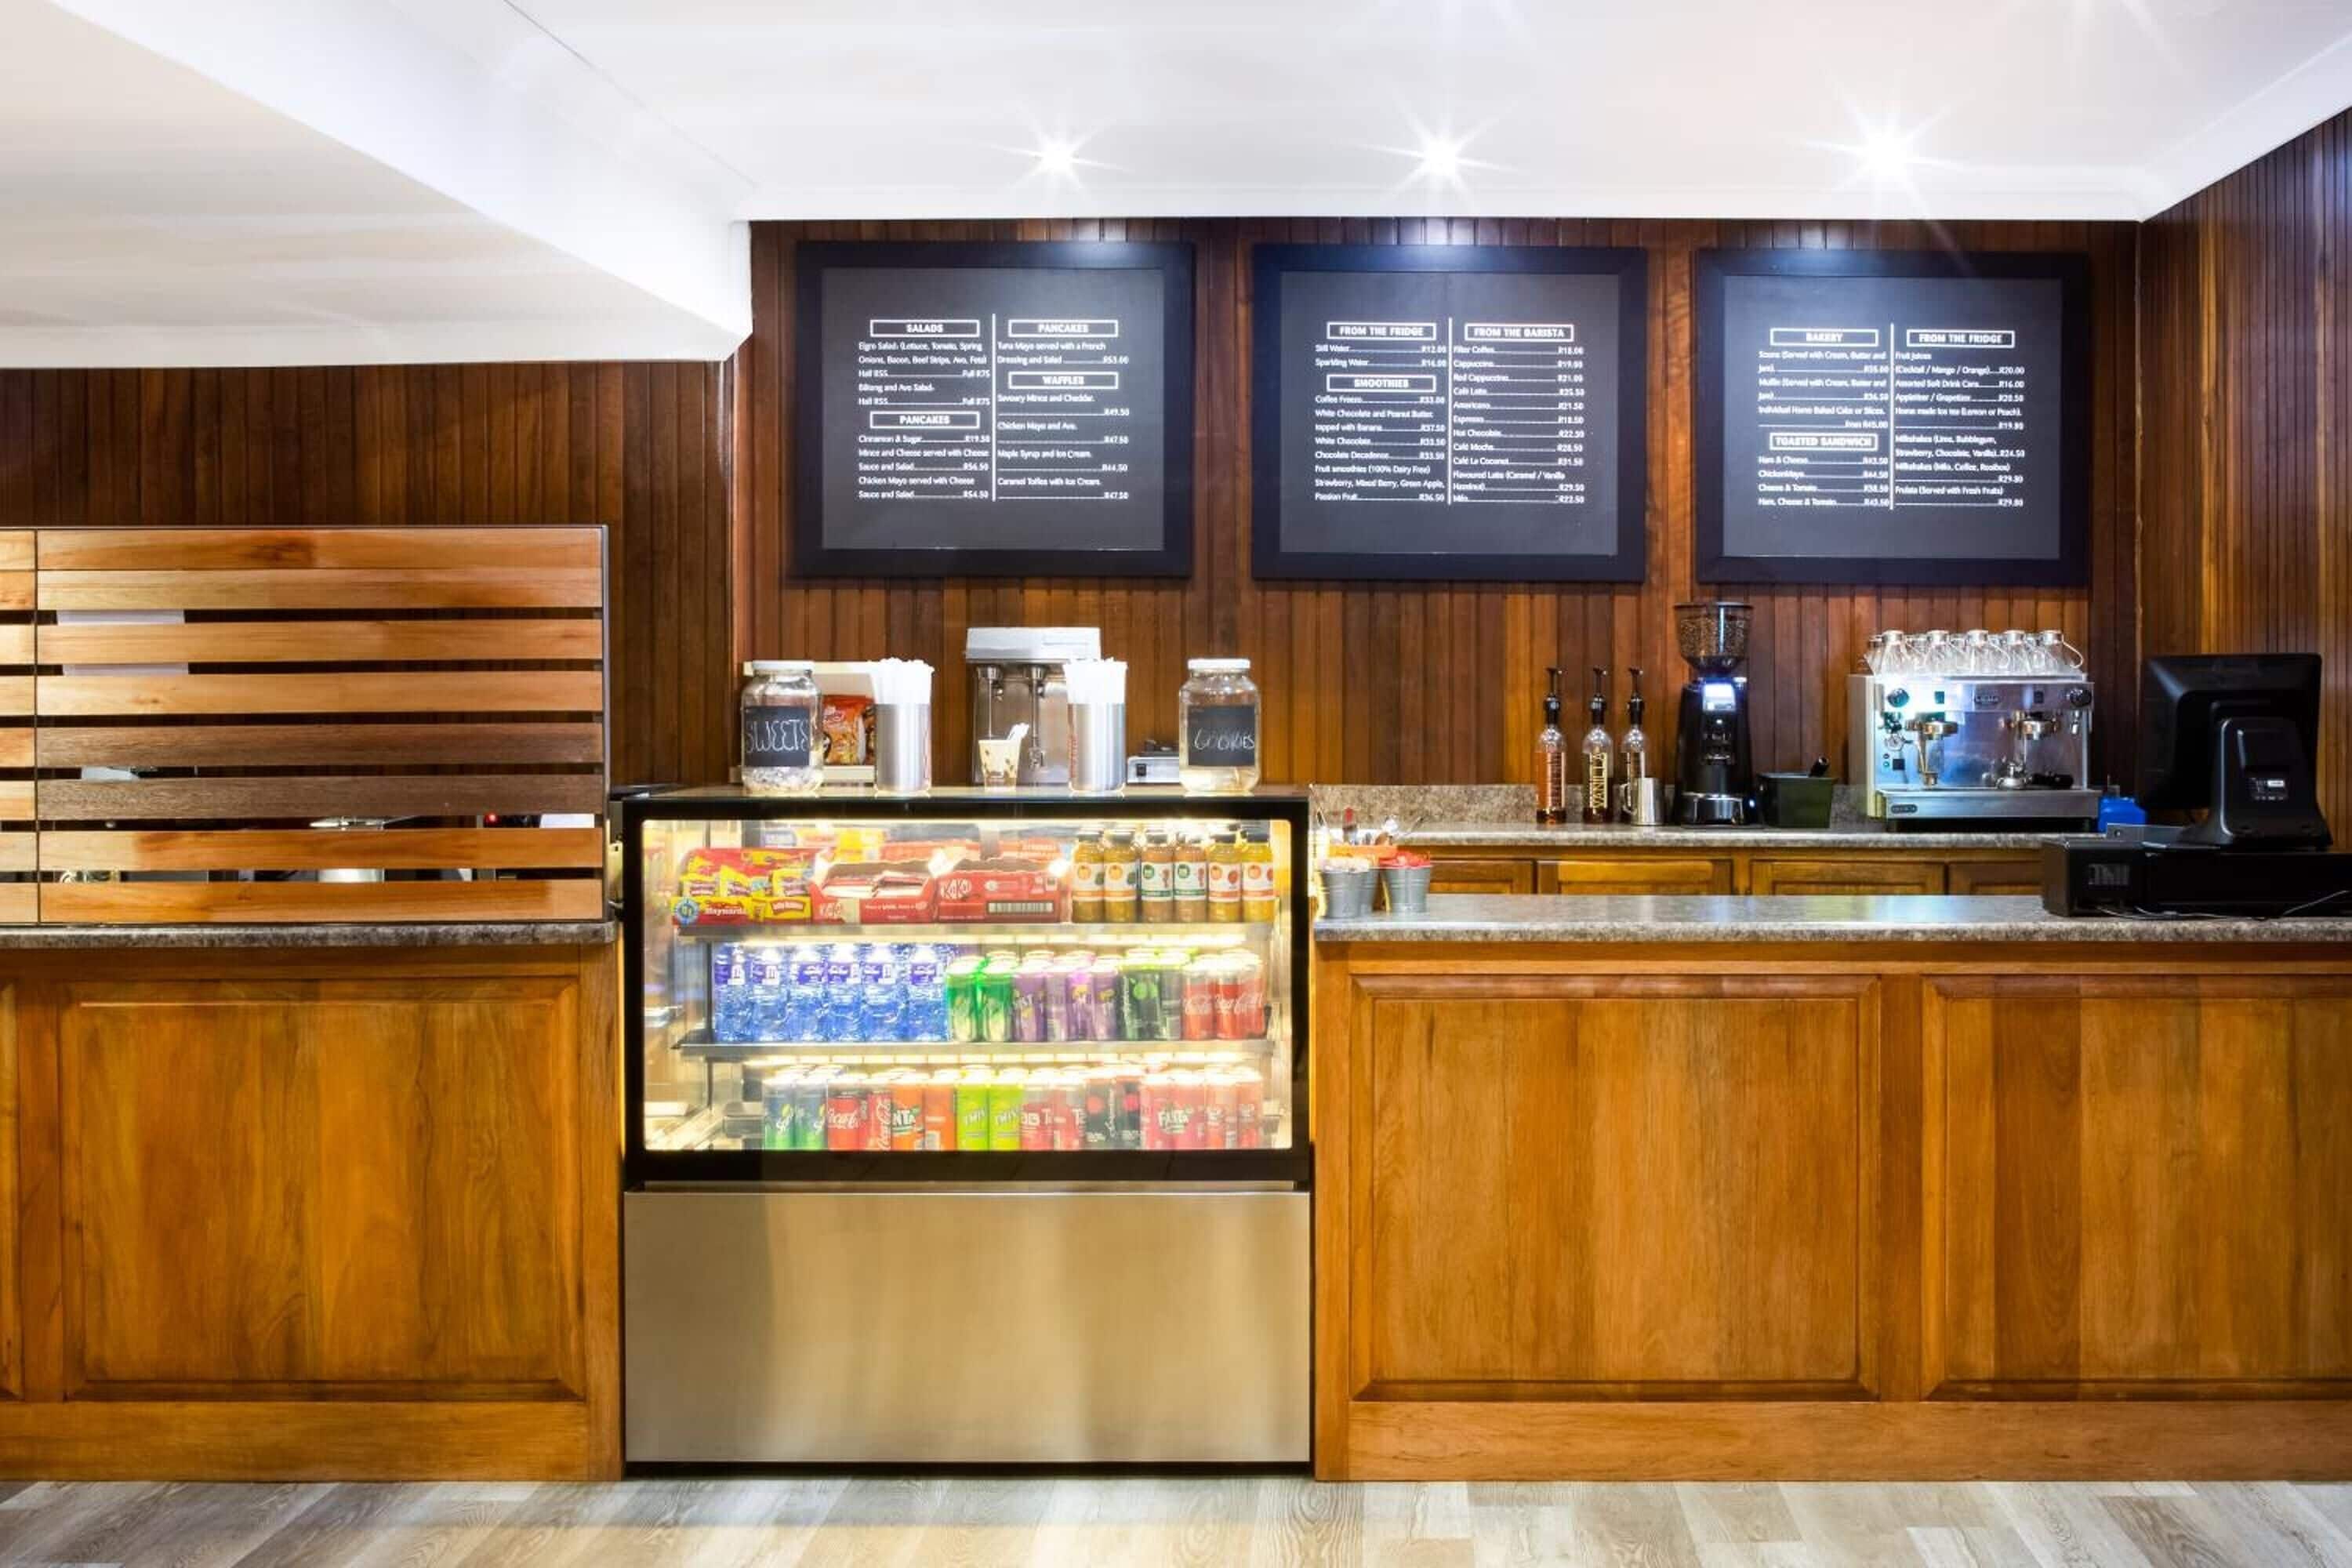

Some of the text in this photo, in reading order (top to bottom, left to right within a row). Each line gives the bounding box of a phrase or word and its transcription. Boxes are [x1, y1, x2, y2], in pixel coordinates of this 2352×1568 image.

[906, 324, 943, 332] SALADS
[1038, 323, 1089, 332] PANCAKES
[1340, 325, 1424, 336] FROM THE FRIDGE
[1474, 328, 1564, 337] FROM THE BARISTA
[1806, 332, 1843, 342] BAKERY
[1918, 333, 2002, 343] FROM THE FRIDGE
[960, 342, 982, 351] Spring
[1014, 342, 1034, 351] Mayo
[1316, 358, 1347, 368] Sparkling
[1043, 376, 1084, 385] WAFFLES
[1354, 379, 1409, 388] SMOOTHIES
[899, 416, 950, 424] PANCAKES
[1316, 423, 1339, 433] topped
[1775, 436, 1818, 445] TOASTED
[964, 448, 989, 457] Cheese
[997, 450, 1018, 459] Maple
[1020, 450, 1040, 459] Syrup
[1393, 466, 1411, 475] Dairy
[887, 477, 907, 486] Mayo
[746, 718, 808, 753] SWEETS
[1592, 752, 1605, 809] VANILLA
